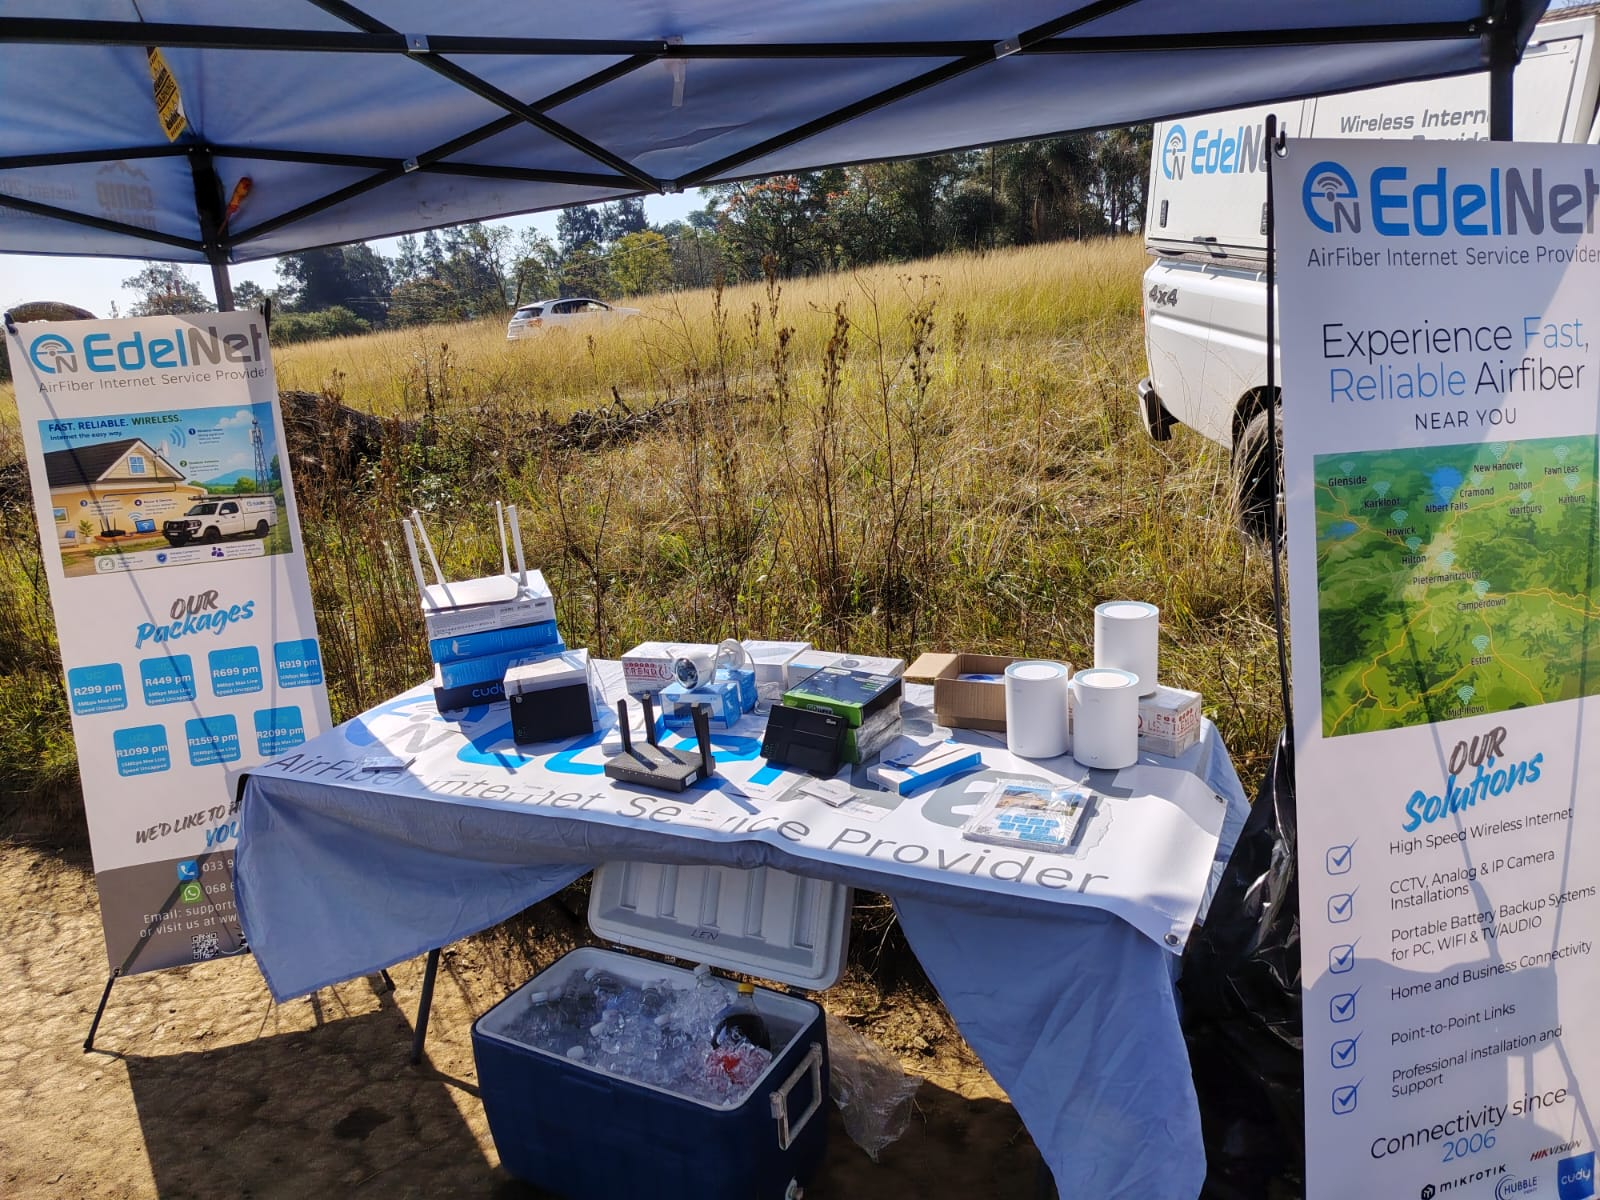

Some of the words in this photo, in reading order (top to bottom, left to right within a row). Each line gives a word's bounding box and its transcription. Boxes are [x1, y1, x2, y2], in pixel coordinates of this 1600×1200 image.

[1340, 108, 1415, 133] Wireless
[1369, 166, 1600, 236] EdelNet
[1308, 247, 1381, 267] AirFiber
[1387, 248, 1458, 267] Internet
[1466, 247, 1529, 266] Service
[1536, 245, 1600, 263] Provider
[1149, 284, 1178, 307] 4x4
[83, 323, 263, 373] EdelNet
[1323, 320, 1513, 364] Experience
[1522, 316, 1589, 352] Fast,
[40, 379, 94, 393] AirFiber
[100, 375, 156, 389] Internet
[161, 371, 212, 385] Service
[216, 366, 269, 384] Provider
[1330, 361, 1466, 403] Reliable
[1474, 357, 1586, 395] Airfiber
[48, 422, 77, 433] FAST.
[78, 419, 129, 431] RELIABLE.
[131, 414, 183, 427] WIRELESS.
[1415, 410, 1469, 430] NEAR
[1476, 407, 1517, 426] YOU
[1473, 464, 1490, 473] New
[1492, 461, 1523, 472] Hanover
[1544, 466, 1561, 476] Fawn
[1563, 464, 1579, 474] Leas
[1328, 475, 1367, 487] Glenside
[1460, 486, 1494, 498] Cramond
[1509, 480, 1532, 490] Dalton
[1425, 503, 1448, 514] Albert
[1450, 501, 1469, 511] Falls
[1386, 526, 1416, 537] Howick
[1401, 554, 1427, 564] Hilton
[1412, 570, 1481, 585] Pietermaritzburg
[170, 590, 218, 620] OUR
[1457, 597, 1506, 612] Camperdown
[135, 600, 255, 650] Packages
[279, 660, 302, 670] R919
[303, 659, 318, 668] pm
[1471, 655, 1491, 666] Eston
[144, 676, 172, 687] R449
[175, 675, 191, 685] pm
[213, 668, 239, 678] R699
[242, 666, 259, 676] pm
[74, 685, 102, 696] R299
[105, 684, 122, 693] pm
[188, 735, 219, 747] R1599
[221, 734, 237, 743] pm
[256, 728, 287, 739] R2099
[289, 727, 304, 736] pm
[116, 746, 149, 758] R1099
[151, 745, 168, 754] pm
[1448, 726, 1507, 776] OUR
[1402, 752, 1543, 833] Solutions
[136, 822, 171, 844] WE'D
[174, 810, 206, 833] LIKE
[208, 804, 225, 821] TO
[1389, 837, 1423, 856] High
[1426, 828, 1467, 849] Speed
[1470, 817, 1523, 839] Wireless
[1525, 807, 1574, 828] Internet
[616, 795, 810, 842] Seice
[828, 827, 1110, 893] Provider
[203, 861, 224, 872] 033
[1389, 876, 1428, 895] CCTV,
[1431, 866, 1477, 886] Analog
[1480, 862, 1489, 875] &
[1491, 859, 1504, 873] IP
[1506, 849, 1555, 869] Camera
[206, 883, 227, 895] 068
[1391, 884, 1469, 910] Installations
[144, 909, 181, 924] Email:
[1391, 919, 1447, 941] Portable
[1451, 909, 1496, 929] Battery
[1499, 896, 1546, 919] Backup
[1548, 885, 1596, 907] Systems
[140, 928, 152, 938] or
[156, 921, 181, 935] visit
[186, 920, 200, 930] us
[204, 916, 215, 926] at
[691, 927, 719, 941] LEN
[1391, 948, 1410, 963] for
[1413, 942, 1435, 960] PC,
[1437, 933, 1467, 952] WIFI
[1470, 931, 1479, 944] &
[1482, 915, 1542, 940] TV/AUDIO
[1391, 980, 1432, 1000] Home
[1435, 973, 1459, 991] and
[1462, 960, 1518, 984] Business
[1519, 940, 1593, 969] Connectivity
[1391, 1012, 1481, 1046] Point-to-Point
[1483, 1003, 1516, 1021] Links
[1392, 1051, 1468, 1082] Professional
[1470, 1033, 1537, 1062] installation
[1539, 1024, 1562, 1041] and
[1391, 1073, 1444, 1098] Support
[1370, 1101, 1508, 1159] Connectivity
[1512, 1087, 1567, 1116] since
[1441, 1128, 1497, 1163] 2006
[1529, 1139, 1582, 1162] HIKVISION
[1504, 1176, 1538, 1195] HUBBLE
[1561, 1167, 1591, 1185] cudy
